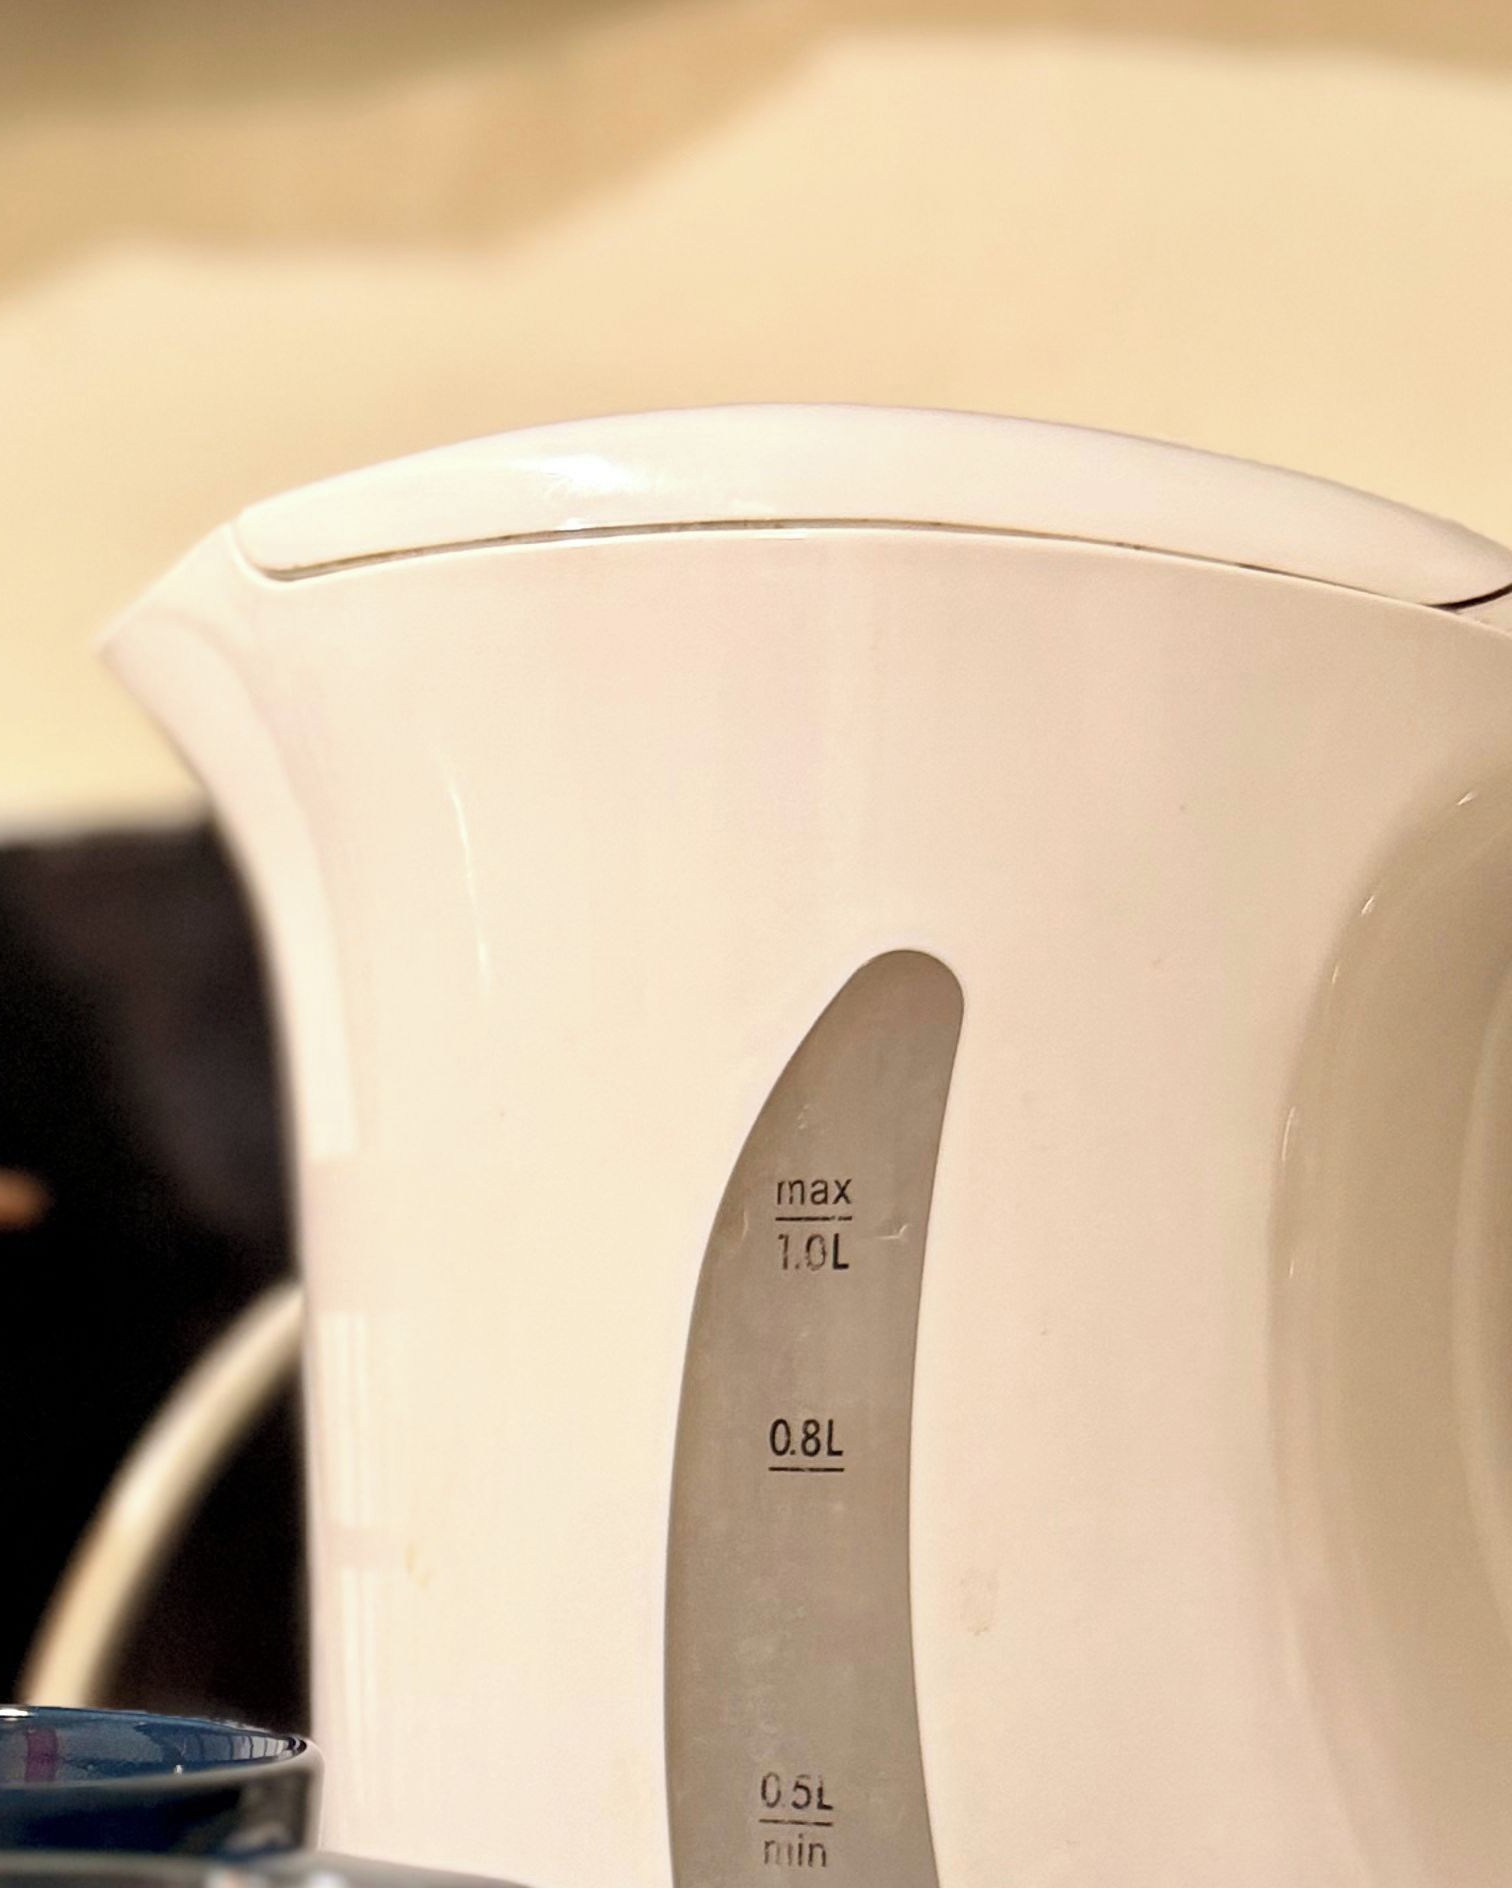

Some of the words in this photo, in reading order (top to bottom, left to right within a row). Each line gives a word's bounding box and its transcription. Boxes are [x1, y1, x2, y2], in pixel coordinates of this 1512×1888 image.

[776, 1178, 852, 1206] max
[776, 1232, 850, 1271] 1.0L
[769, 1418, 844, 1457] 0.8L
[763, 1832, 828, 1868] min
